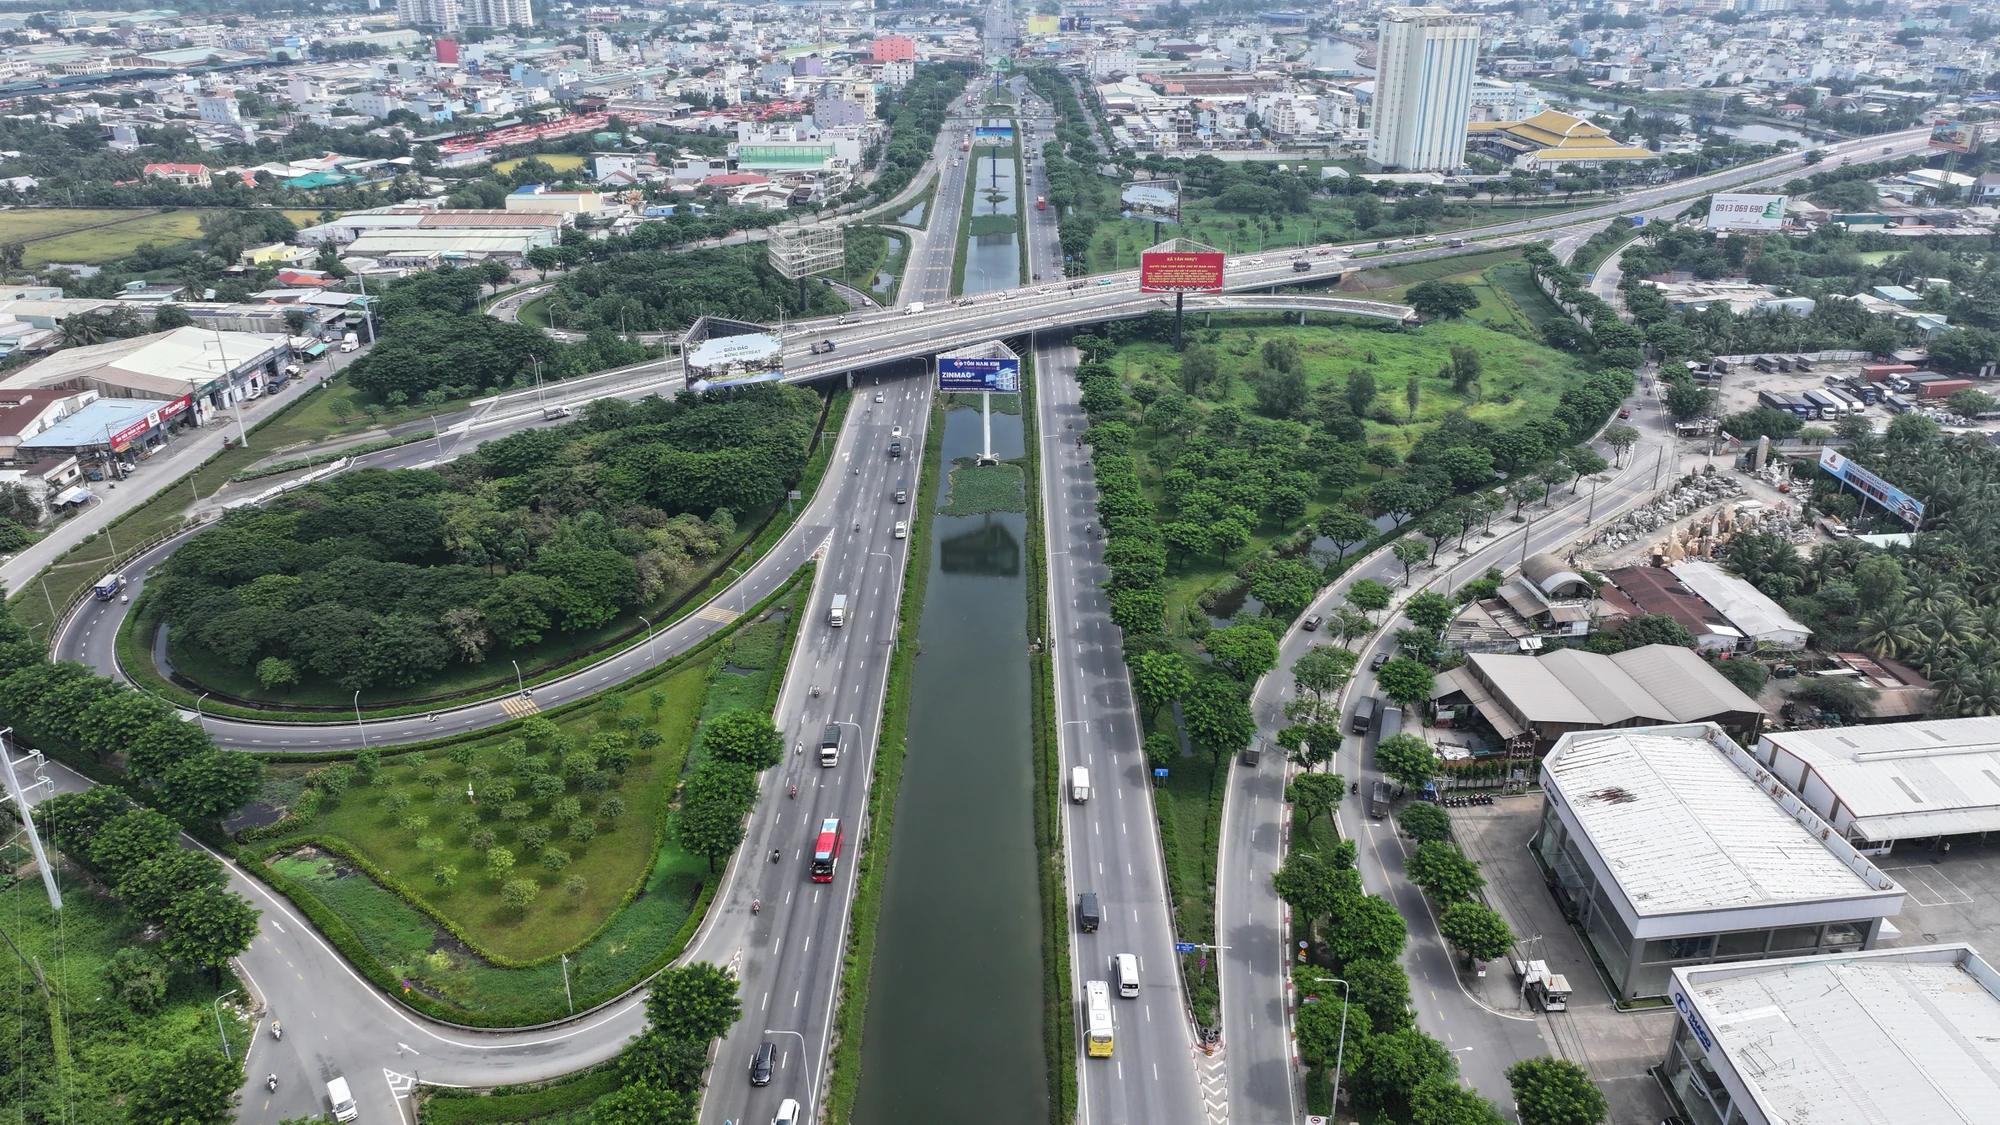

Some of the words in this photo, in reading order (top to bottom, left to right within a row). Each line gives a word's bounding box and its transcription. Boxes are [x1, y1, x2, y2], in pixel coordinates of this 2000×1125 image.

[1715, 204, 1733, 212] 0913
[1734, 204, 1748, 213] 069
[1749, 205, 1764, 213] 690
